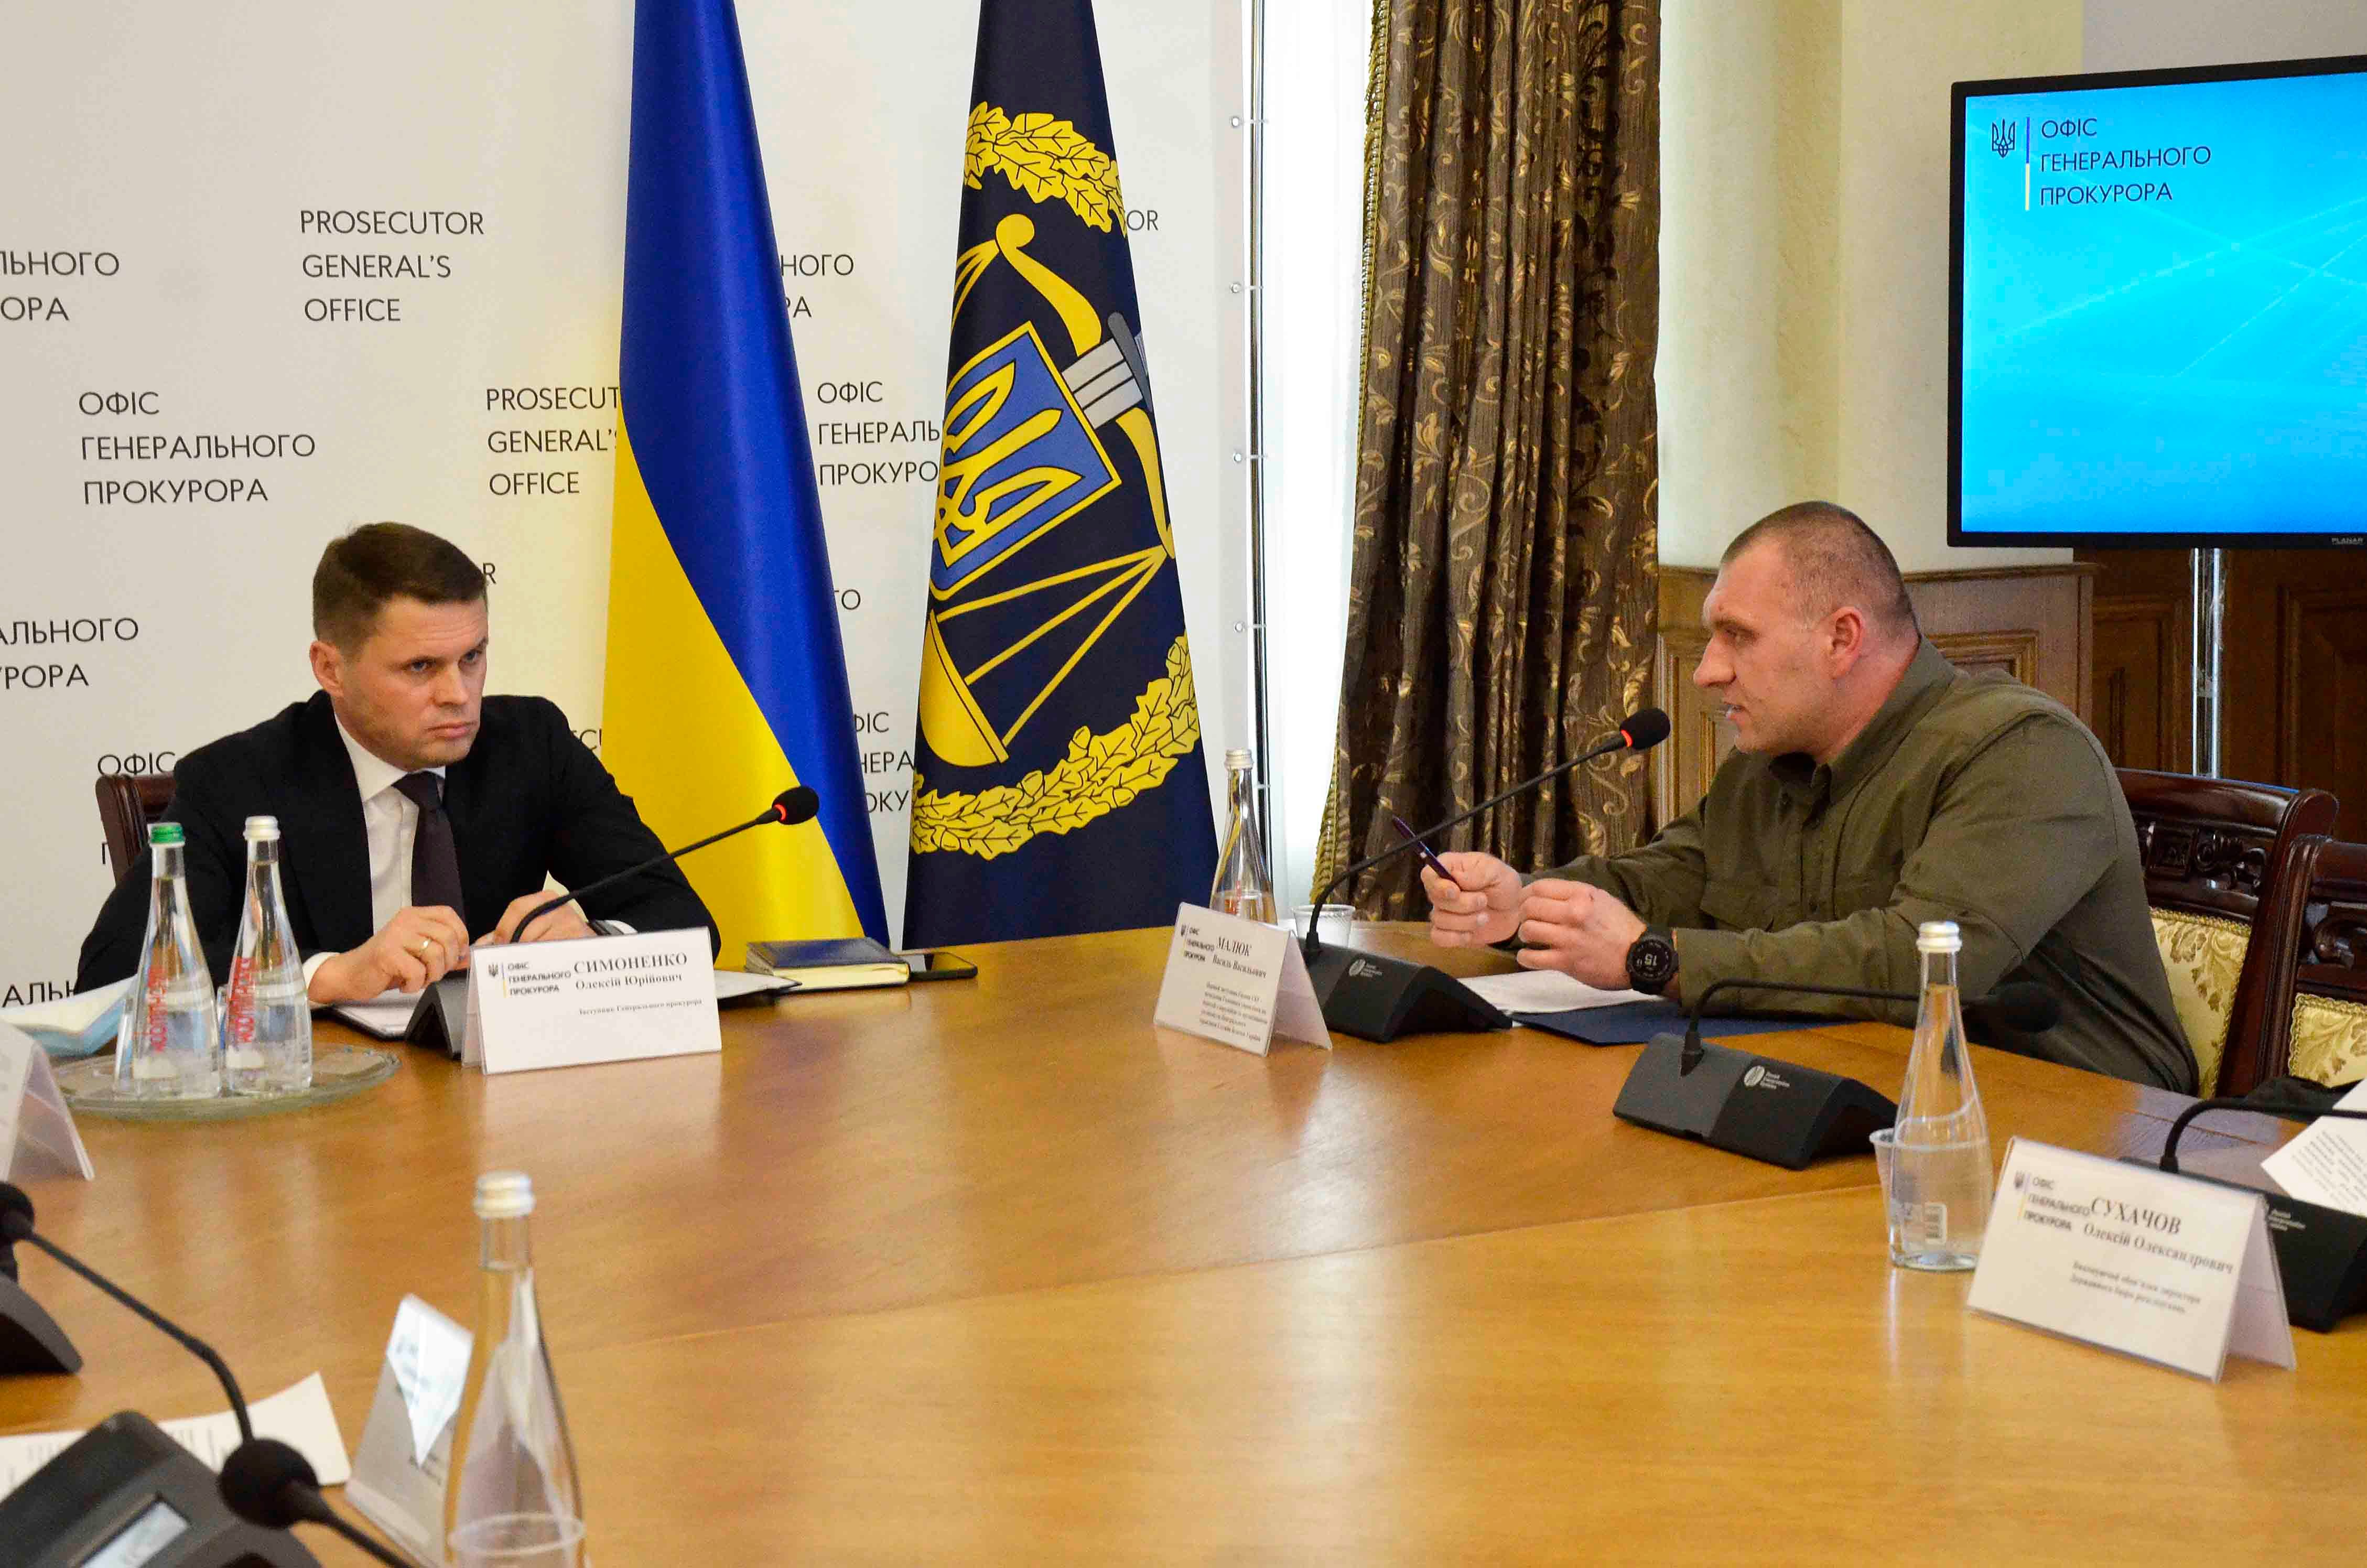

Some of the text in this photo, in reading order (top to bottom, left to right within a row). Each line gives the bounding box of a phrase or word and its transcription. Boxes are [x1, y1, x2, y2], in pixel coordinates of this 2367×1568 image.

[2042, 118, 2097, 137] ОФІС
[2041, 146, 2211, 172] ГЕНЕРАЛЬНОГО
[2040, 182, 2173, 206] ПРОКУРОРА
[300, 210, 484, 235] PROSECUTOR
[302, 255, 451, 278] GENERAL'S
[1, 297, 69, 321] ОРА
[305, 299, 401, 321] OFFICE
[79, 392, 159, 415] ОФІС
[487, 387, 618, 411] PROSECUT
[818, 381, 883, 404] ОФІС
[488, 429, 617, 453] GENERAL'
[818, 420, 940, 445] ГЕНЕРАЛЬ
[82, 435, 315, 460] ГЕНЕРАЛЬНОГО
[490, 472, 580, 495] OFFICE
[820, 461, 938, 486] ПРОКУРО
[84, 478, 268, 504] ПРОКУРОРА
[0, 664, 89, 690] РОРА
[98, 751, 176, 775] ОФІС
[1216, 936, 1252, 956] МАЛЮК
[574, 952, 687, 974] СИМОНЕНКО
[509, 970, 571, 984] ГЕНЕРАЛЬНОГО
[576, 973, 683, 990] Олексій Юрійович
[510, 985, 560, 996] ПРОКУРОРА
[2091, 1197, 2181, 1234] СУХАЧОВ
[2084, 1222, 2233, 1274] Олексій Олександрович
